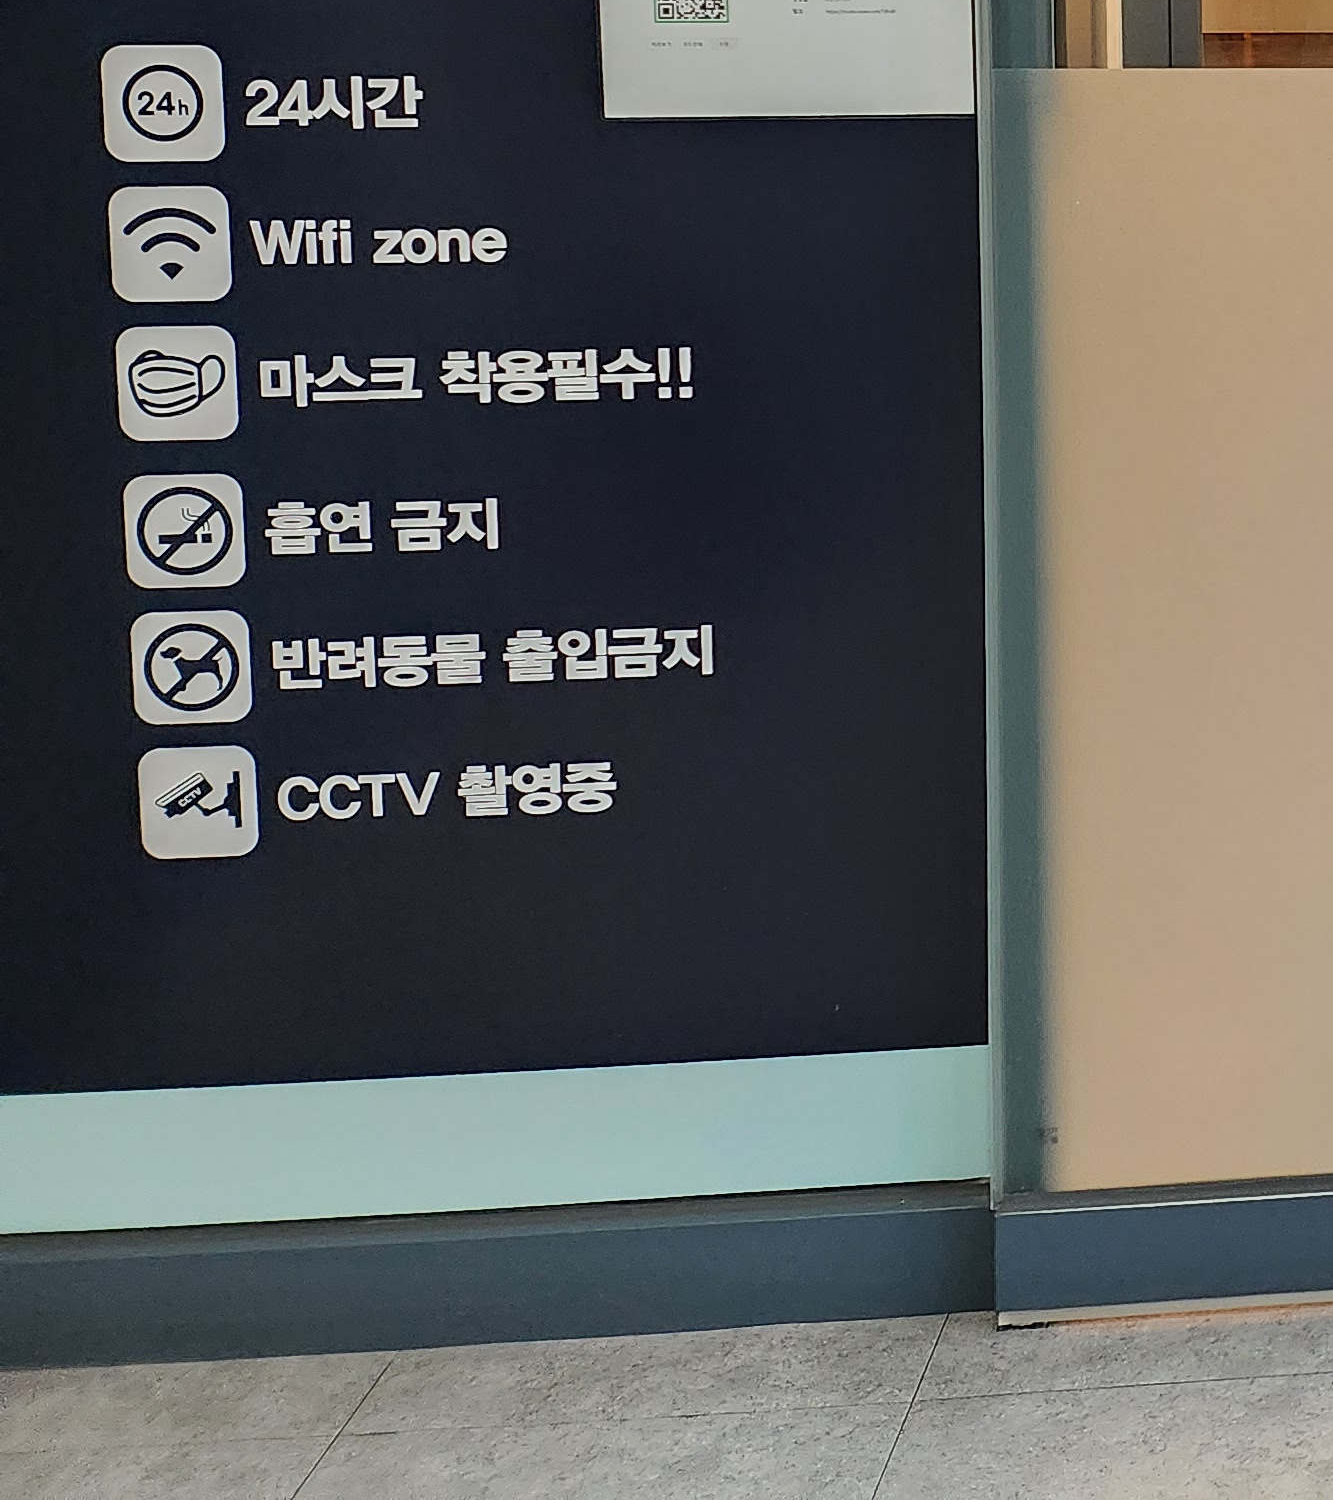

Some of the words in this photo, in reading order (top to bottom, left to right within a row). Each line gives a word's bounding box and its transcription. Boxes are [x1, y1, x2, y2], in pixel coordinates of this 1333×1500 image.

[136, 91, 190, 117] 24h
[243, 75, 423, 131] 24시간
[250, 219, 352, 266] Wifi
[371, 224, 509, 264] zone
[257, 353, 425, 408] 마스크
[439, 346, 695, 405] 착용필수!!
[264, 501, 373, 557] 흡연
[391, 498, 501, 553] 금지
[271, 634, 487, 690] 반려동물
[502, 624, 716, 685] 출입금지
[178, 787, 202, 807] CCTV
[277, 771, 440, 823] CCTV
[457, 761, 619, 818] 촬영중
